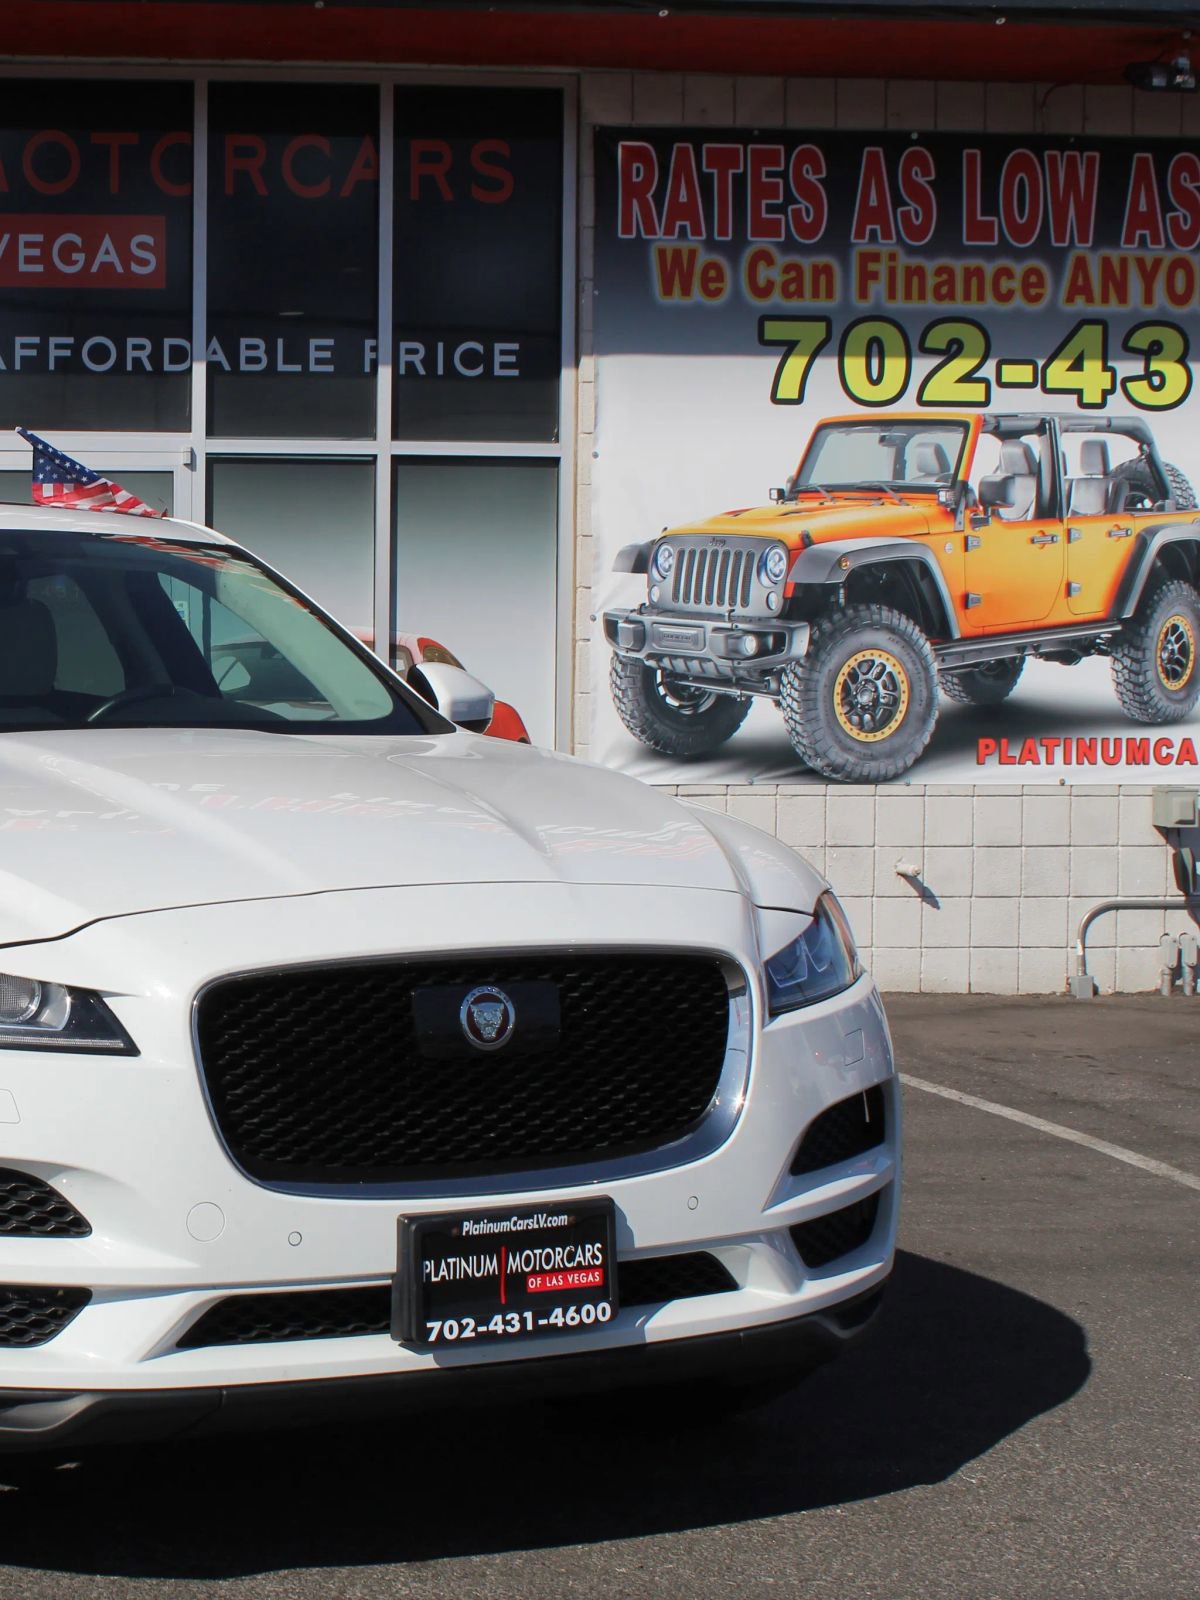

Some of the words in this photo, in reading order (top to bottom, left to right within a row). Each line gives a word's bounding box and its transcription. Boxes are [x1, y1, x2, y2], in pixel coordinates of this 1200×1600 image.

[618, 141, 828, 242] RATES
[851, 147, 936, 245] AS
[963, 148, 1099, 247] LOW
[1121, 152, 1200, 250] AS
[655, 247, 727, 299] We
[746, 247, 836, 301] Can
[857, 249, 1047, 305] Finance
[1065, 254, 1196, 308] ANYO
[757, 314, 1193, 411] 702-43
[976, 737, 1199, 766] PLATINUMCA
[462, 1213, 568, 1236] PlatinumCarsLV.com
[423, 1253, 499, 1283] PLATINUM
[507, 1243, 602, 1274] MOTORCARS
[528, 1277, 542, 1288] OF
[546, 1274, 564, 1287] LAS
[567, 1271, 601, 1284] VEGAS
[426, 1302, 612, 1342] 702-431-4600
